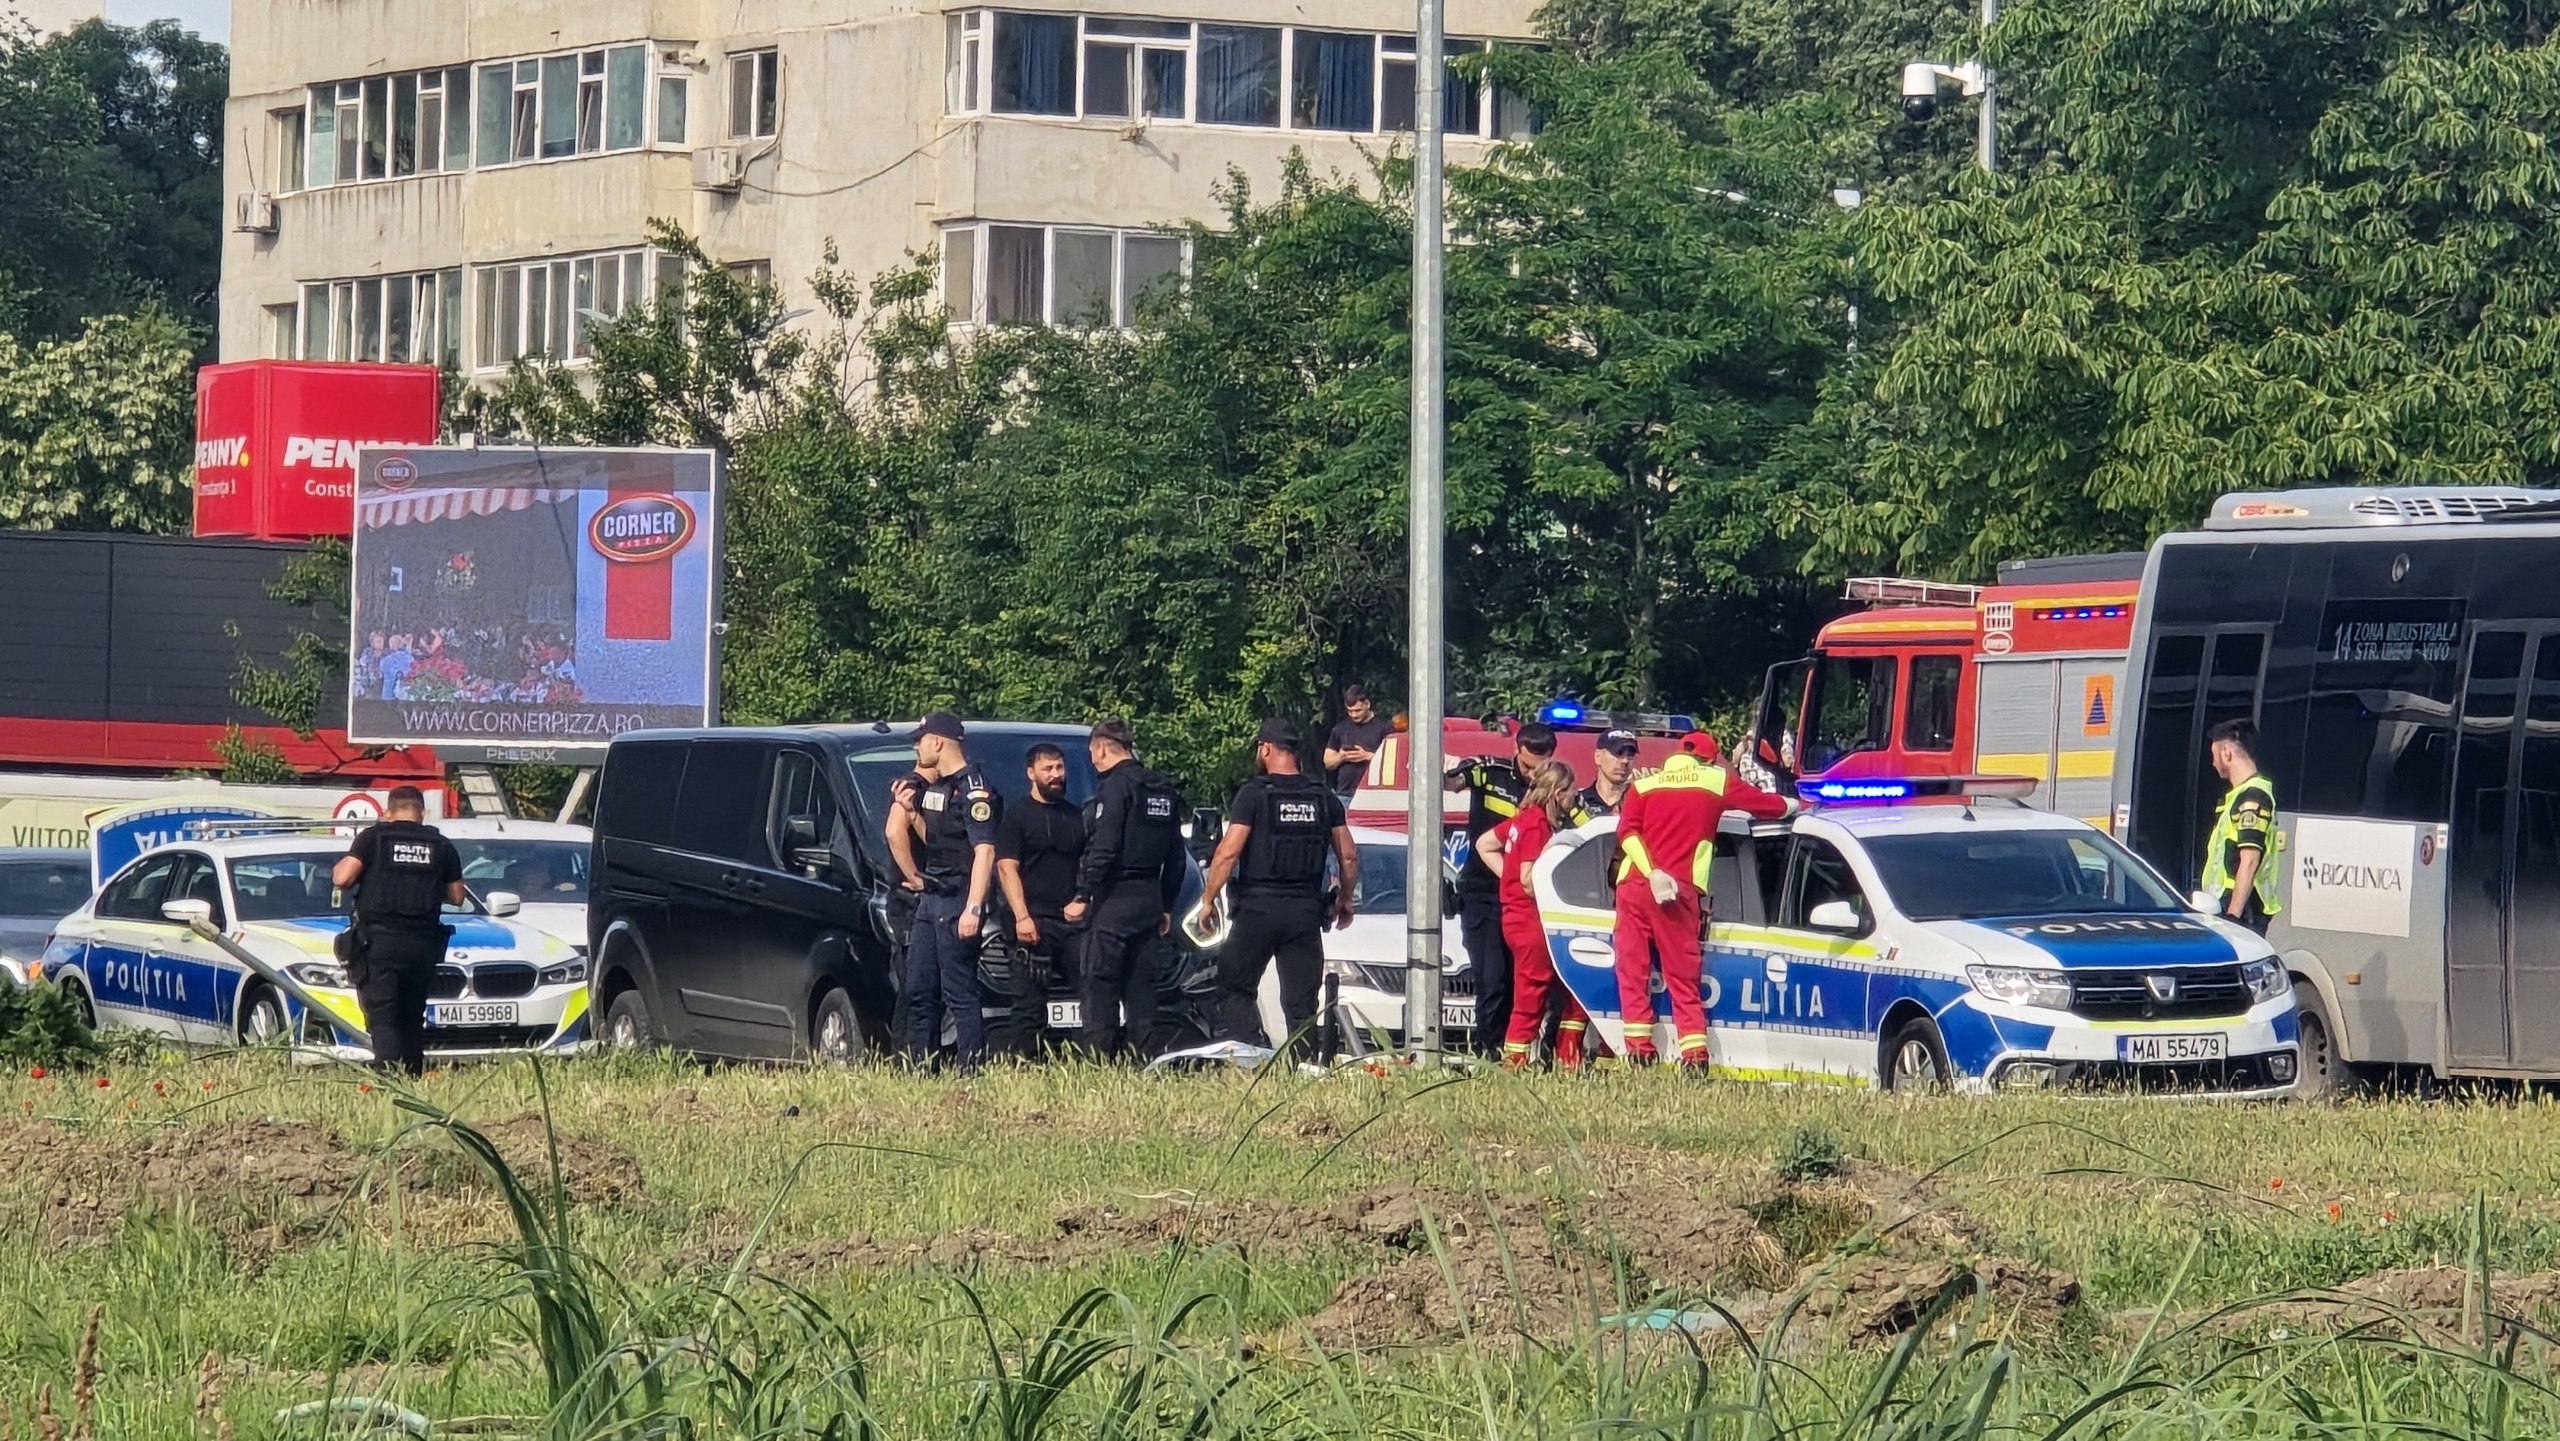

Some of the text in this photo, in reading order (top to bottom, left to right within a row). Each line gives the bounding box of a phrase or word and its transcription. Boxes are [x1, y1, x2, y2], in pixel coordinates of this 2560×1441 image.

[284, 437, 358, 469] PEN
[305, 479, 353, 497] Const
[604, 511, 676, 538] CORNER
[403, 709, 645, 734] WWW.CORNERPIZZA.RO
[2321, 862, 2402, 891] BIOCLINICA
[440, 1005, 512, 1022] MAI 59968
[1053, 1005, 1063, 1021] B
[2133, 1038, 2219, 1060] MAI 55479
